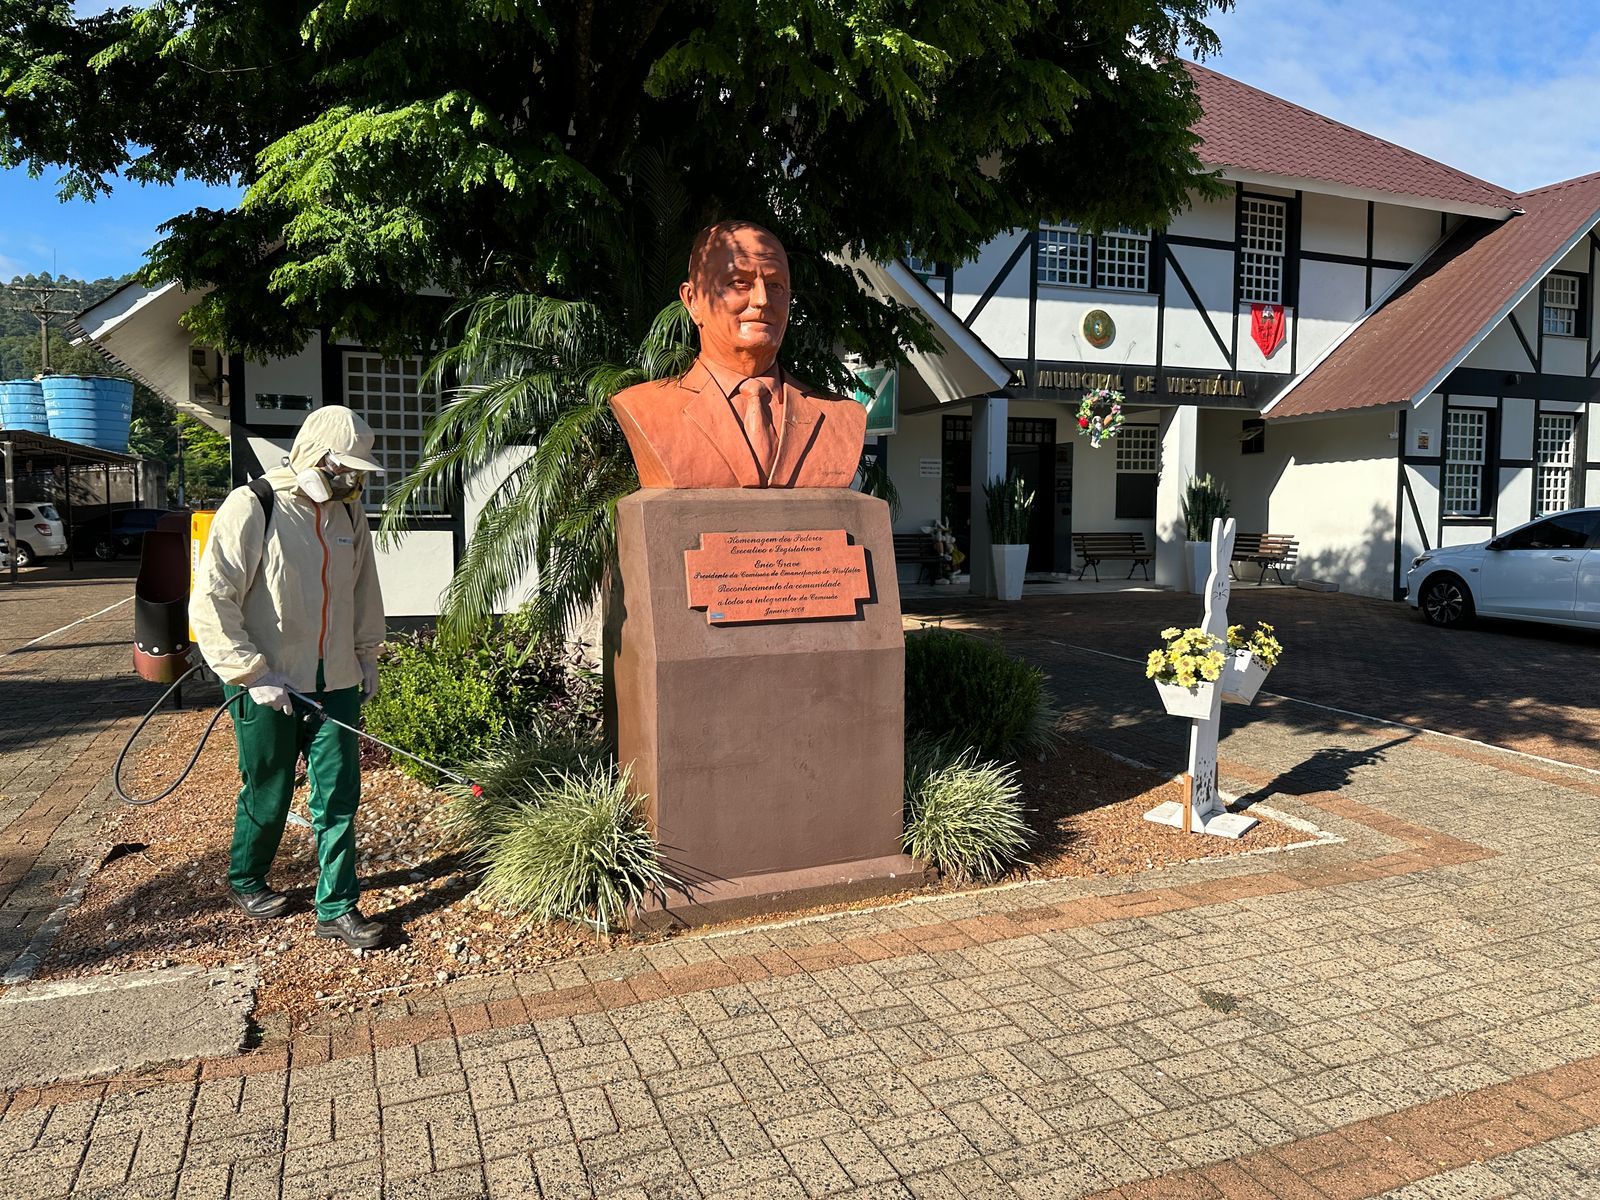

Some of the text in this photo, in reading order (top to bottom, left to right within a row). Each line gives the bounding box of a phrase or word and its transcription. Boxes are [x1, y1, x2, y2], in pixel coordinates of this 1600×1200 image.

[1038, 370, 1125, 391] MUNICIPAL
[1133, 375, 1156, 393] DE
[1166, 373, 1246, 397] WESTFÁLIA
[727, 534, 823, 546] Homenagem dos Poderes
[730, 546, 767, 554] Executivo
[774, 544, 815, 555] Legislativo
[694, 571, 729, 579] Presidente
[717, 579, 841, 593] Reconhecimento da comunidade
[724, 597, 745, 606] todos
[754, 594, 798, 605] integrantes
[809, 593, 839, 601] Comissão
